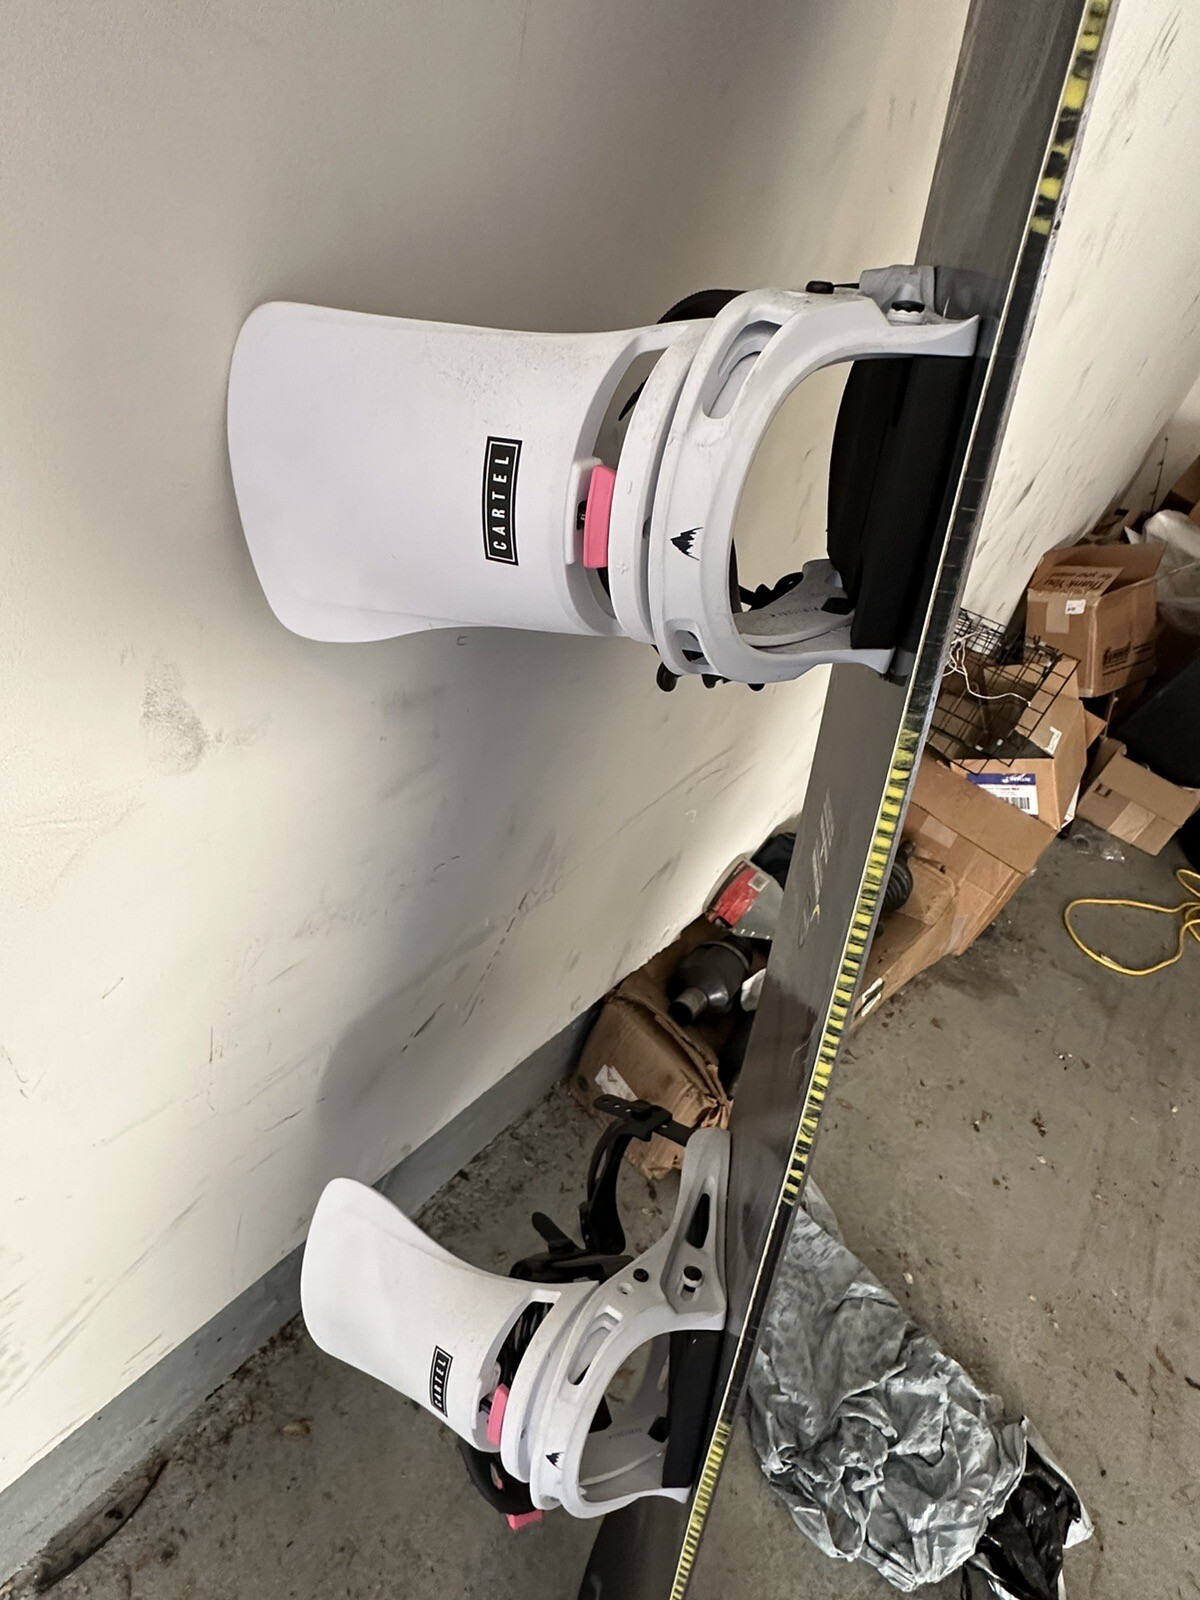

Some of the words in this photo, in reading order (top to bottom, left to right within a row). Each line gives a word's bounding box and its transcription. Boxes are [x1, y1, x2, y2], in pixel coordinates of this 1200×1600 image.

[491, 455, 510, 551] CARTEL
[1043, 579, 1066, 590] You
[1067, 579, 1105, 591] Thank
[433, 1358, 447, 1409] CARTEL
